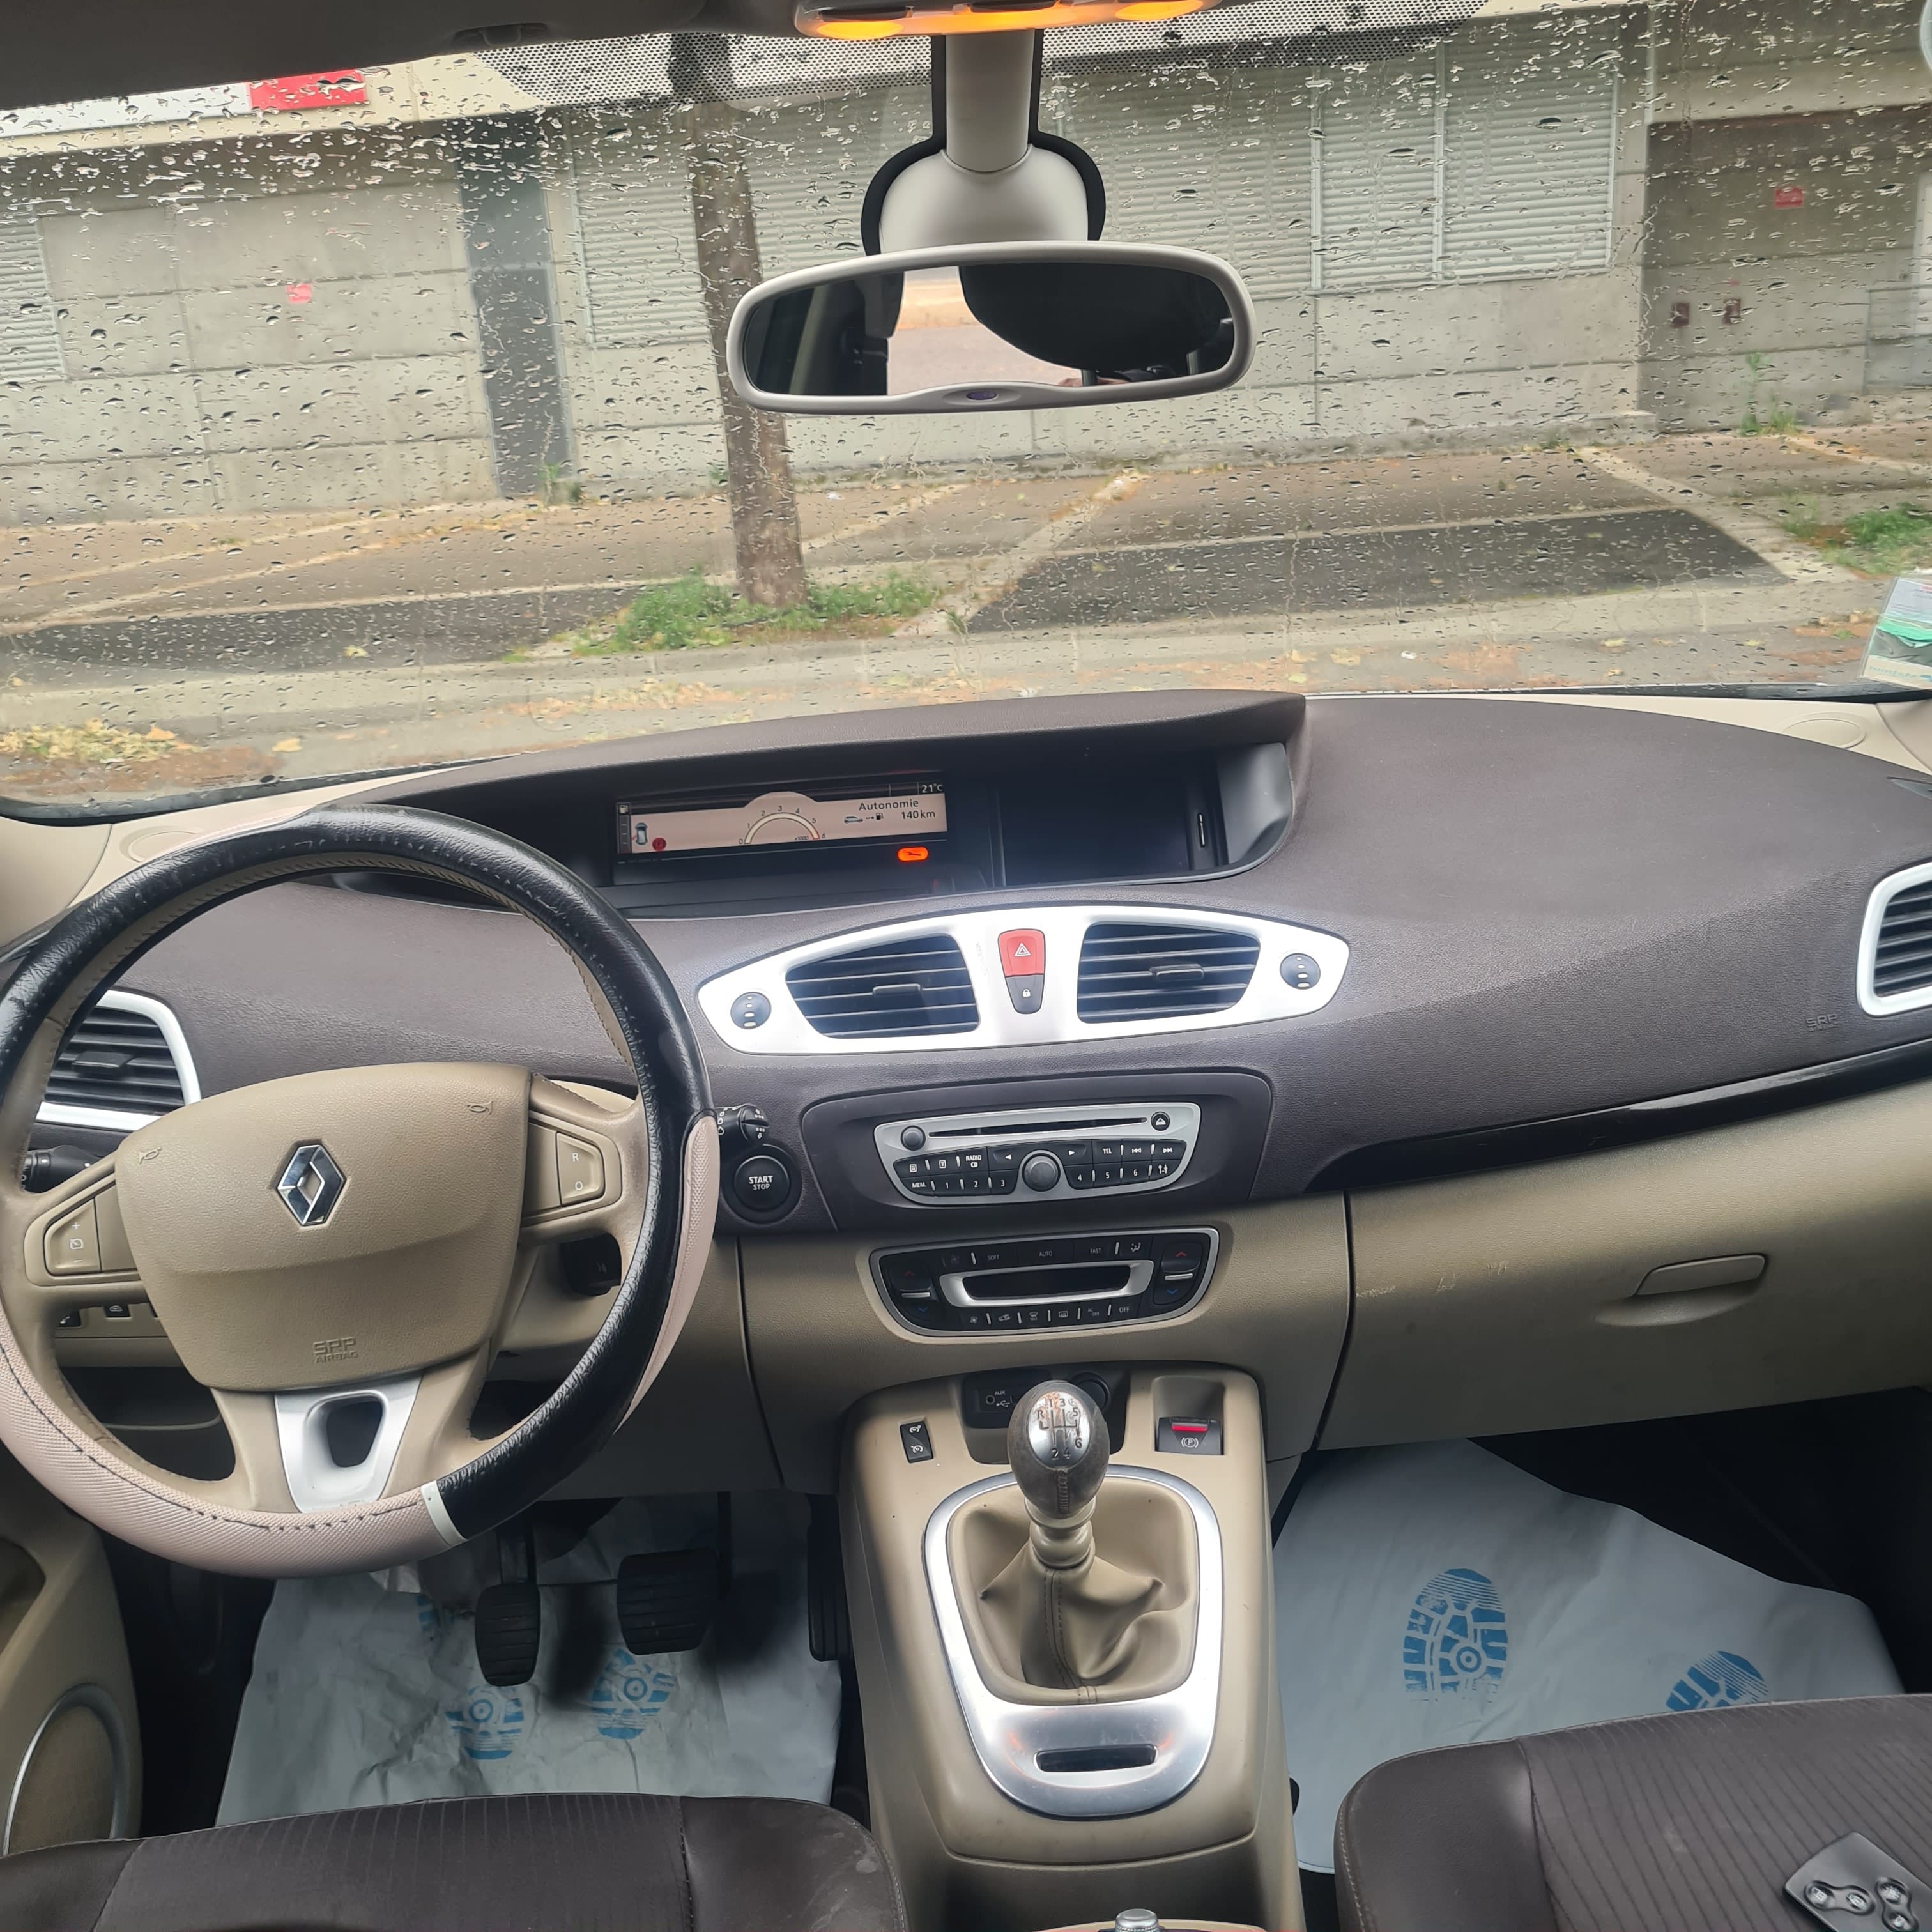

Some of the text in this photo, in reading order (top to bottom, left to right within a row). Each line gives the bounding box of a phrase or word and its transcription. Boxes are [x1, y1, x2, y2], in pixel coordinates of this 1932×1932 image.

[859, 799, 919, 811] Autonomie
[901, 809, 935, 819] 140 km
[572, 1153, 579, 1162] R
[749, 1175, 773, 1184] START
[1049, 1398, 1066, 1407] 1 3
[1037, 1409, 1044, 1420] R
[1072, 1407, 1079, 1416] 5
[1075, 1438, 1082, 1448] 6
[1051, 1448, 1059, 1460] 2
[1063, 1447, 1071, 1459] 4
